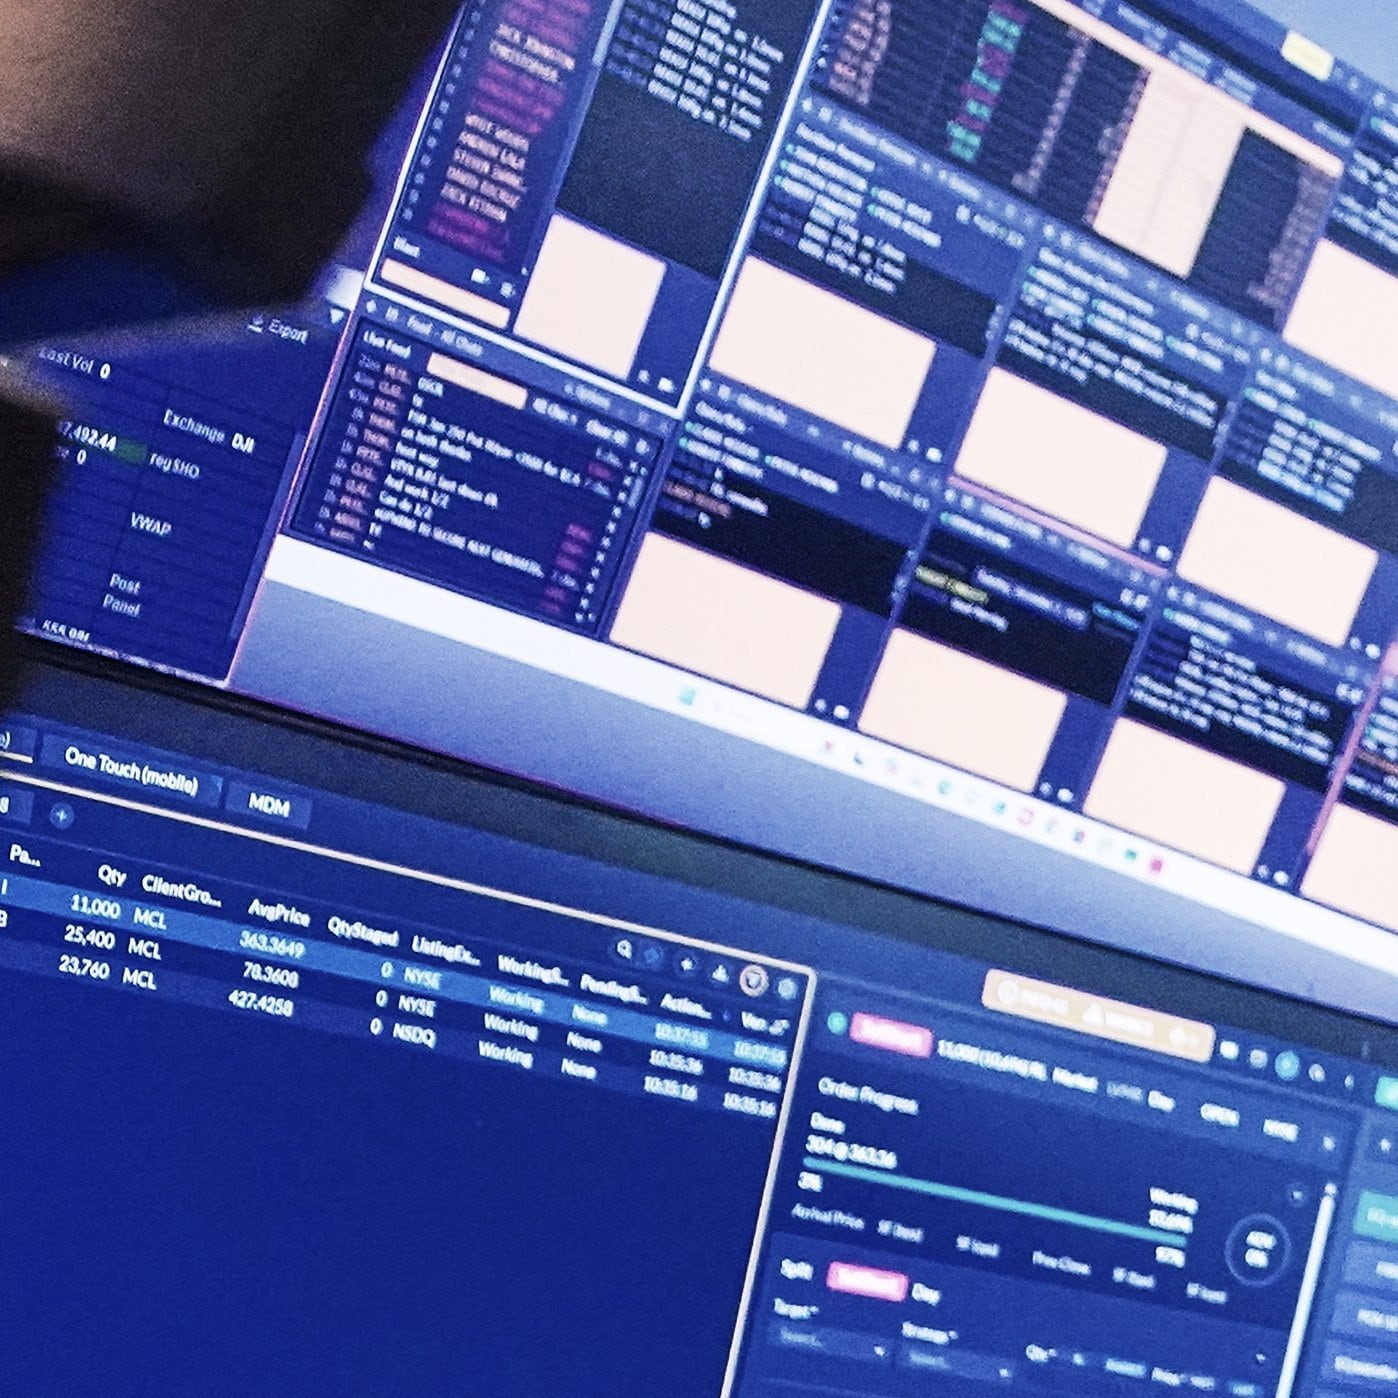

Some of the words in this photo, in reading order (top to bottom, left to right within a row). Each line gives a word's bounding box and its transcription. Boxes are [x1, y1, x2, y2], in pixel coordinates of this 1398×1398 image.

[71, 353, 93, 374] Vol
[100, 363, 111, 380] 0
[60, 420, 117, 452] 7,492.44
[163, 409, 226, 443] Exchange
[231, 432, 255, 454] DJI
[76, 449, 86, 466] 0
[130, 512, 172, 537] VWAP
[110, 573, 140, 595] Post
[102, 594, 140, 618] Panel
[65, 746, 96, 770] One
[99, 754, 140, 781] Touch
[141, 765, 199, 797] (mobile)
[249, 792, 290, 818] MDM
[98, 865, 128, 888] Qty
[248, 899, 311, 928] AvgPrice
[71, 894, 122, 920] 11,000
[133, 907, 168, 930] MCL
[380, 960, 393, 978] 0
[404, 966, 442, 990] NYSE
[64, 924, 116, 950] 25,400
[128, 936, 162, 960] MCL
[376, 989, 388, 1007] 0
[398, 994, 436, 1018] NYSE
[58, 954, 110, 980] 23,760
[122, 967, 157, 990] MCL
[370, 1018, 384, 1036] 0
[392, 1022, 437, 1050] NSDQ
